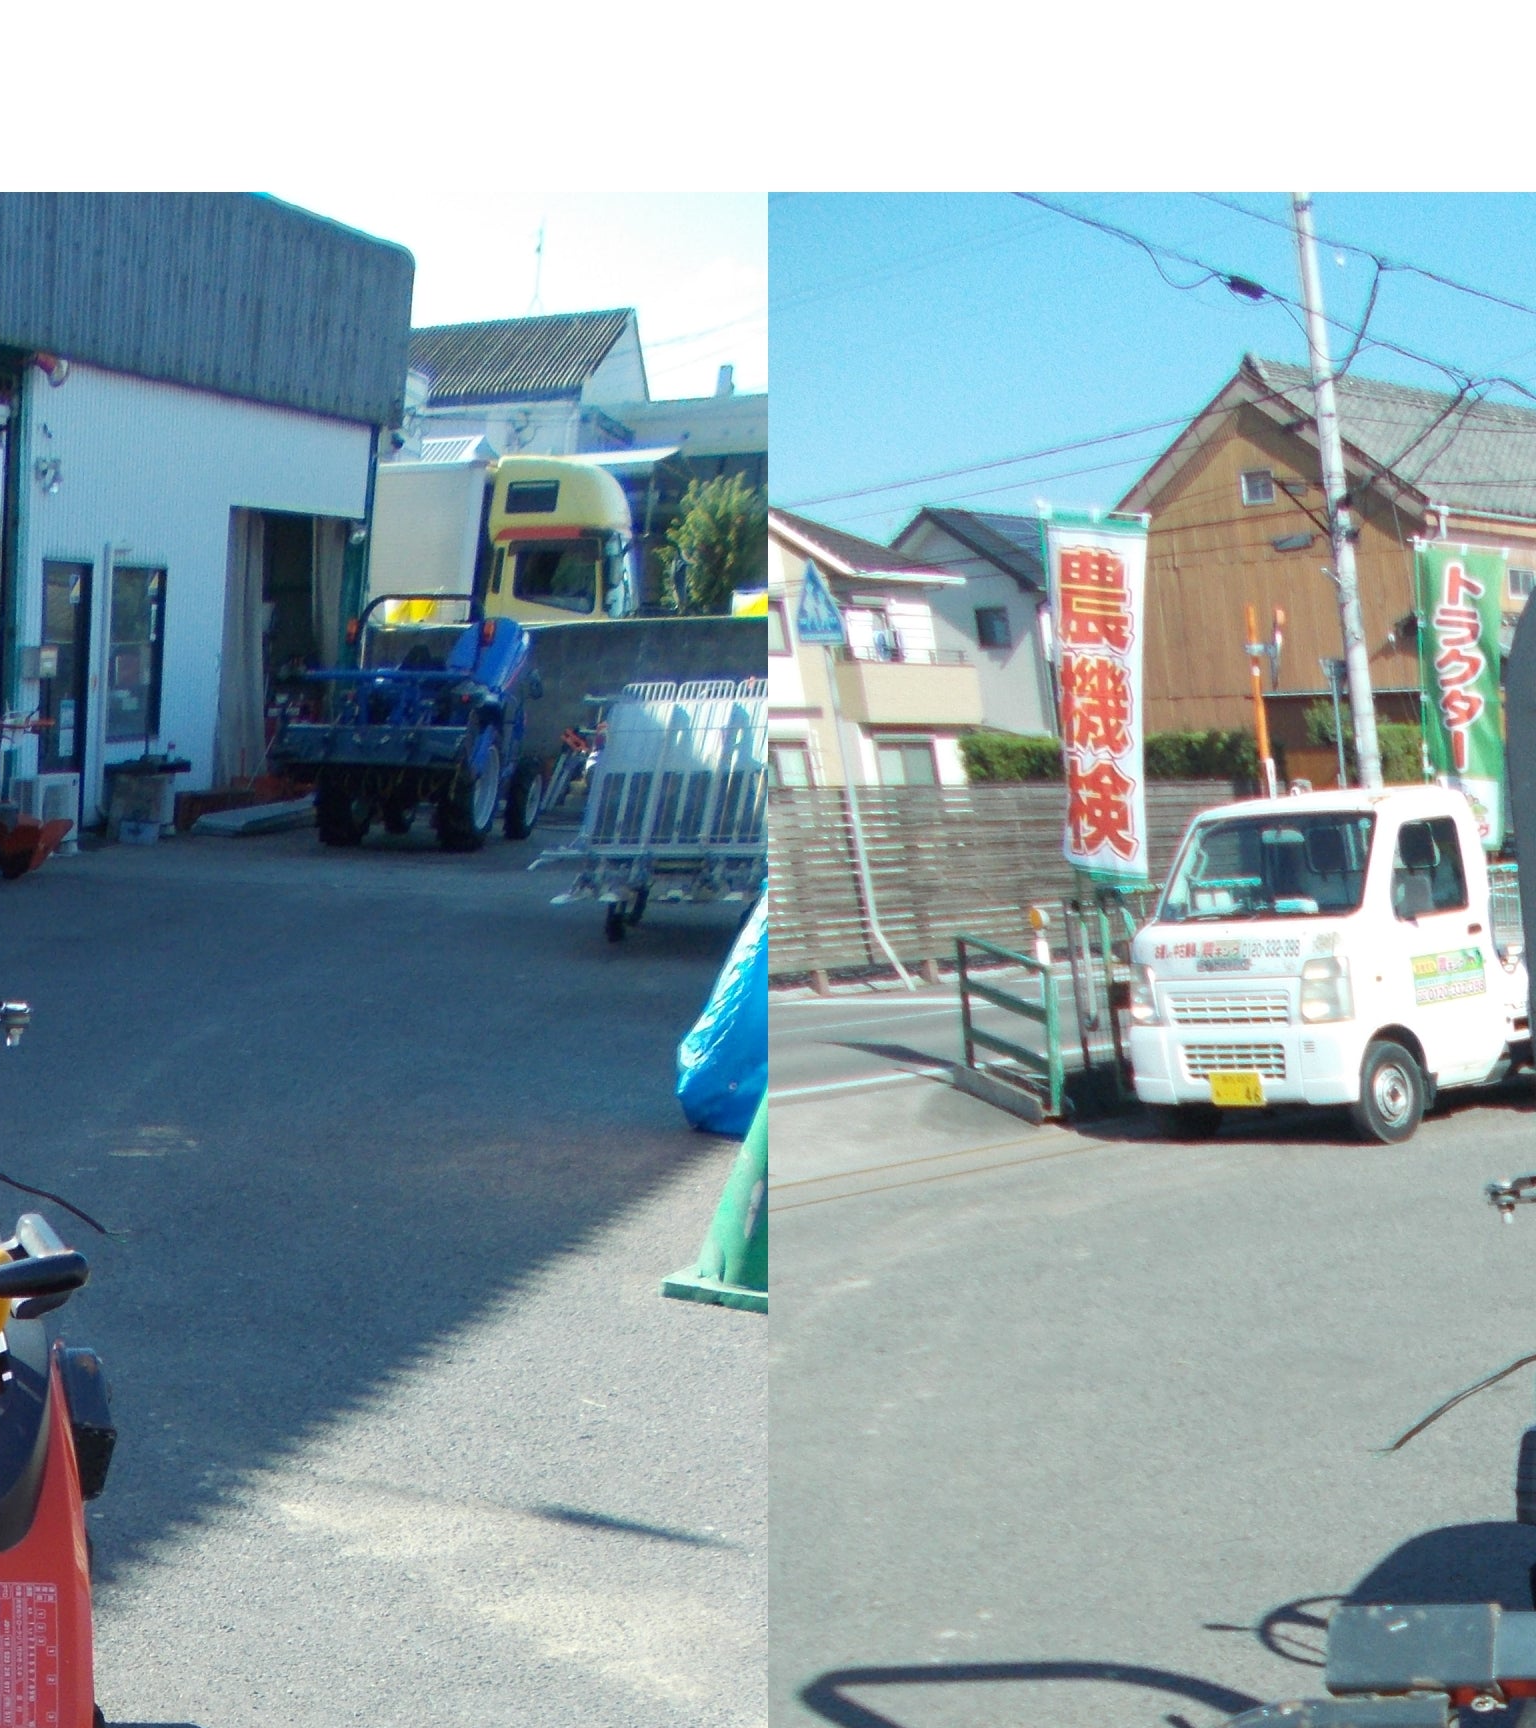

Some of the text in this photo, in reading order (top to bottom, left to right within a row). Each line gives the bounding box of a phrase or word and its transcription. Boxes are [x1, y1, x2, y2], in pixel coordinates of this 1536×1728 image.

[1058, 546, 1138, 861] 農機検
[1435, 562, 1485, 771] トラクター
